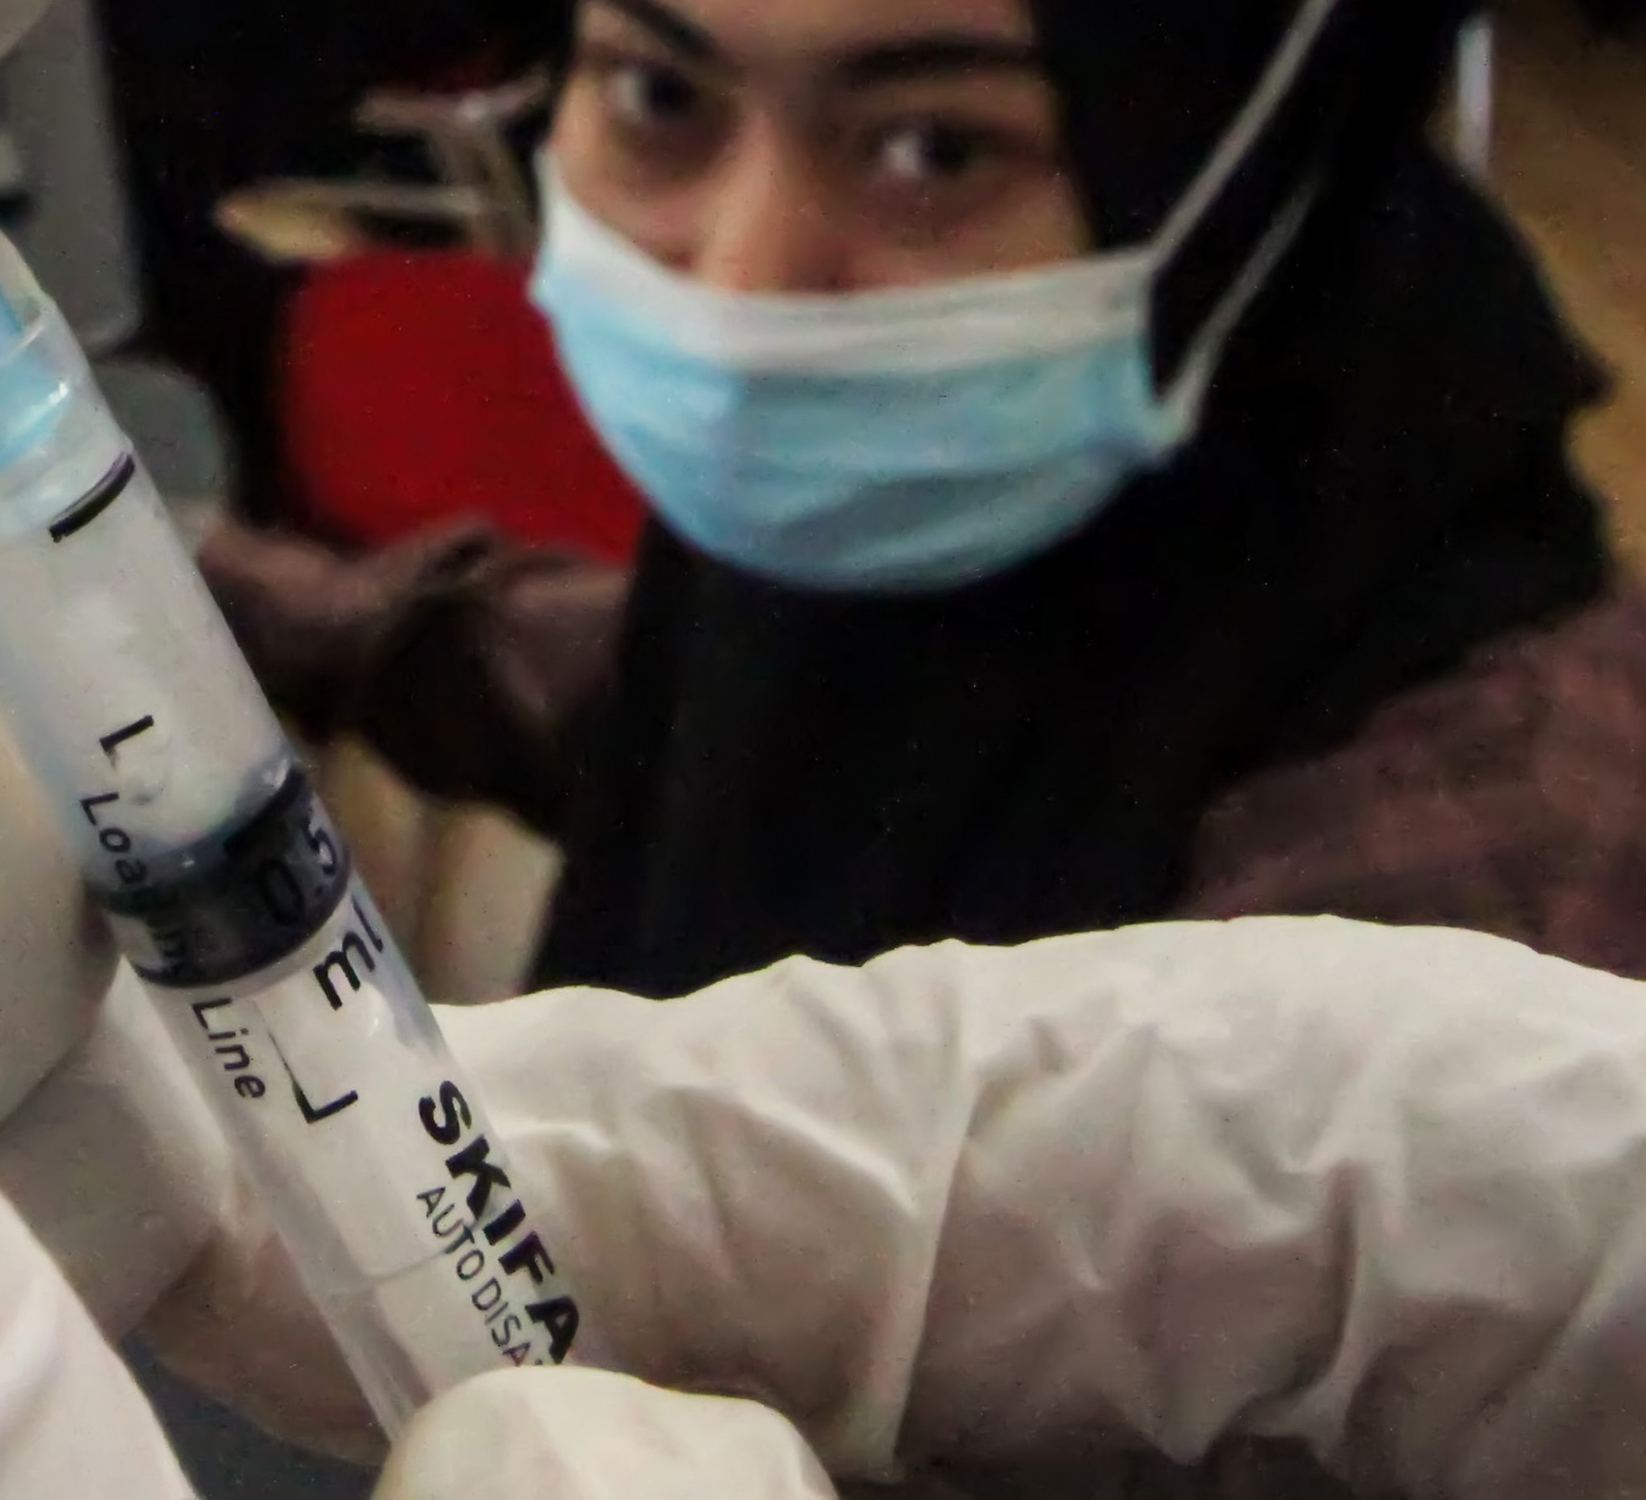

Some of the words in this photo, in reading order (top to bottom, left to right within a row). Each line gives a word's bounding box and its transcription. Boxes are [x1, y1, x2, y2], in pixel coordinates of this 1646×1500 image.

[312, 894, 384, 1011] ml
[192, 997, 266, 1100] Line
[416, 1186, 485, 1281] AUTO
[472, 1277, 543, 1366] DISA
[419, 1080, 579, 1365] SKIFA
